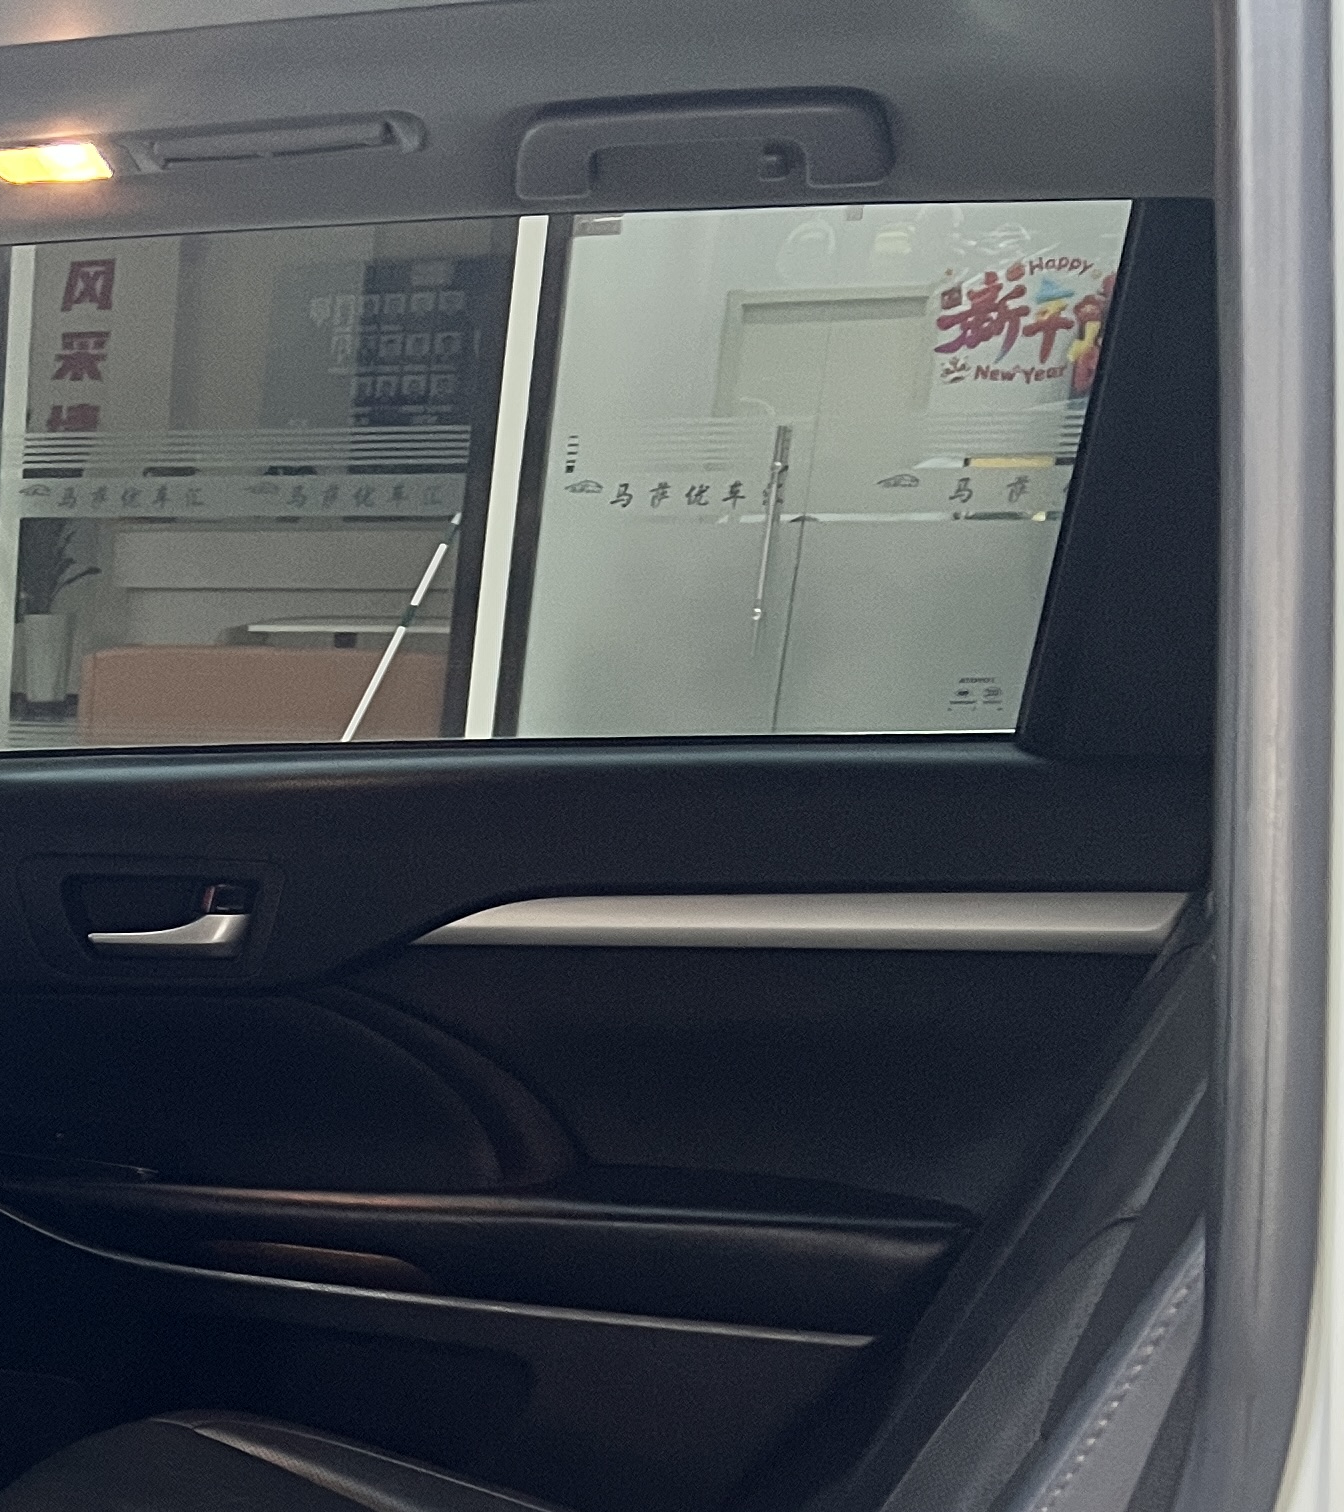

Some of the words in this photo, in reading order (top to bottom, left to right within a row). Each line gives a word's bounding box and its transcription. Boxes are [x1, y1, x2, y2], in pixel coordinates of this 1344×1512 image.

[1029, 257, 1095, 275] Happy
[974, 364, 1015, 381] New
[1021, 365, 1067, 384] Year
[610, 480, 785, 509] 马萨优车
